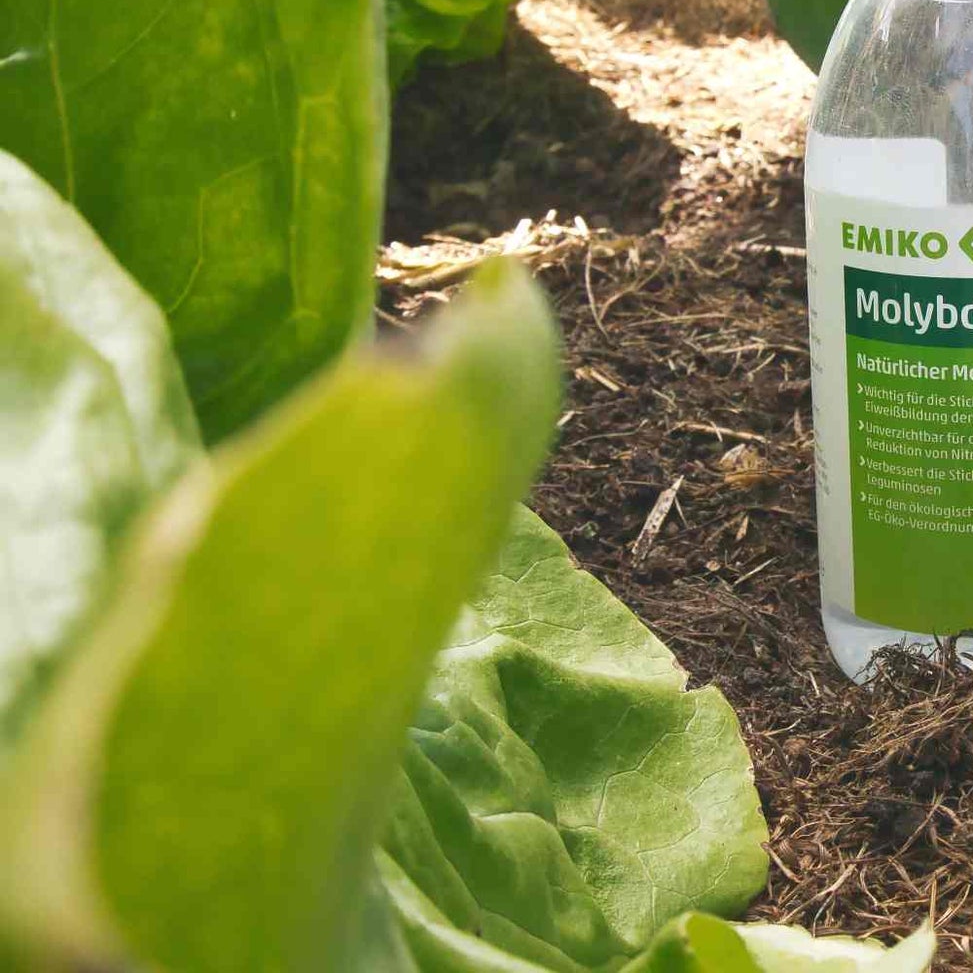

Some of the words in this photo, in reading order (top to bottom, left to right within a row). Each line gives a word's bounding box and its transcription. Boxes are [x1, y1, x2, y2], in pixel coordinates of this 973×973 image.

[842, 222, 948, 259] EMIKO
[856, 353, 949, 380] Natürlicher
[864, 385, 904, 404] Wichtig
[907, 391, 924, 404] für
[927, 393, 946, 407] die
[865, 401, 948, 424] Eiweißbildung
[951, 412, 973, 424] der
[866, 421, 945, 443] Unverzichtbar
[947, 432, 966, 444] für
[866, 437, 922, 457] Reduktion
[924, 448, 948, 459] von
[866, 458, 924, 477] Verbessert
[926, 467, 946, 480] die
[867, 474, 941, 495] Leguminosen
[867, 493, 883, 506] Für
[885, 497, 907, 511] den
